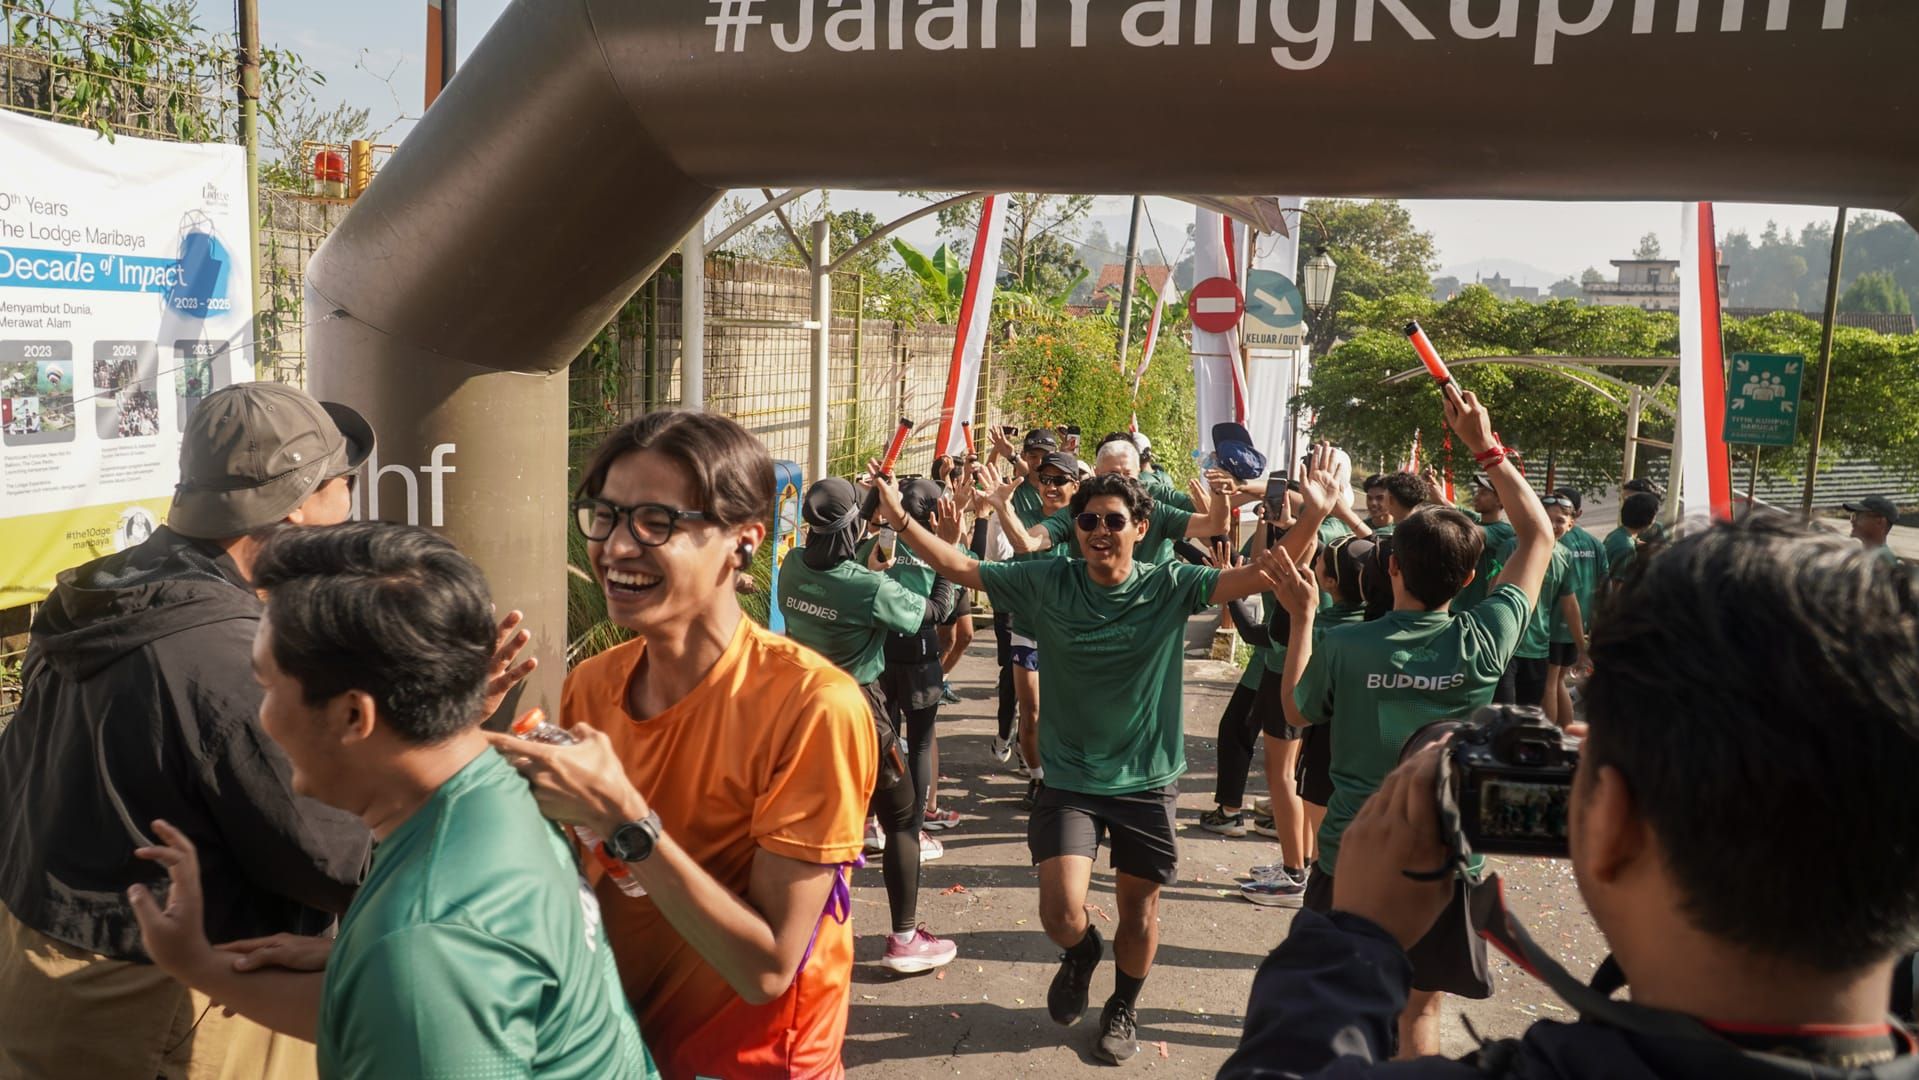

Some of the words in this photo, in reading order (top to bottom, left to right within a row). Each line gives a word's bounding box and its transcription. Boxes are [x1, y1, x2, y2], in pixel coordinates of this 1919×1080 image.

[25, 195, 69, 217] Years
[29, 222, 81, 247] Lodge
[85, 226, 146, 252] Maribaya
[0, 248, 95, 283] Decade
[100, 254, 116, 276] of
[119, 256, 188, 292] Impact
[0, 301, 61, 316] Menyambut
[63, 303, 94, 316] Dunia,
[174, 297, 199, 309] 2023
[206, 297, 231, 310] 2025
[0, 317, 44, 329] Merawat
[46, 318, 72, 330] Alam
[24, 345, 52, 357] 2023
[112, 345, 137, 357] 2024
[786, 596, 838, 621] BUDDIES
[1366, 673, 1465, 691] BUDDIES
